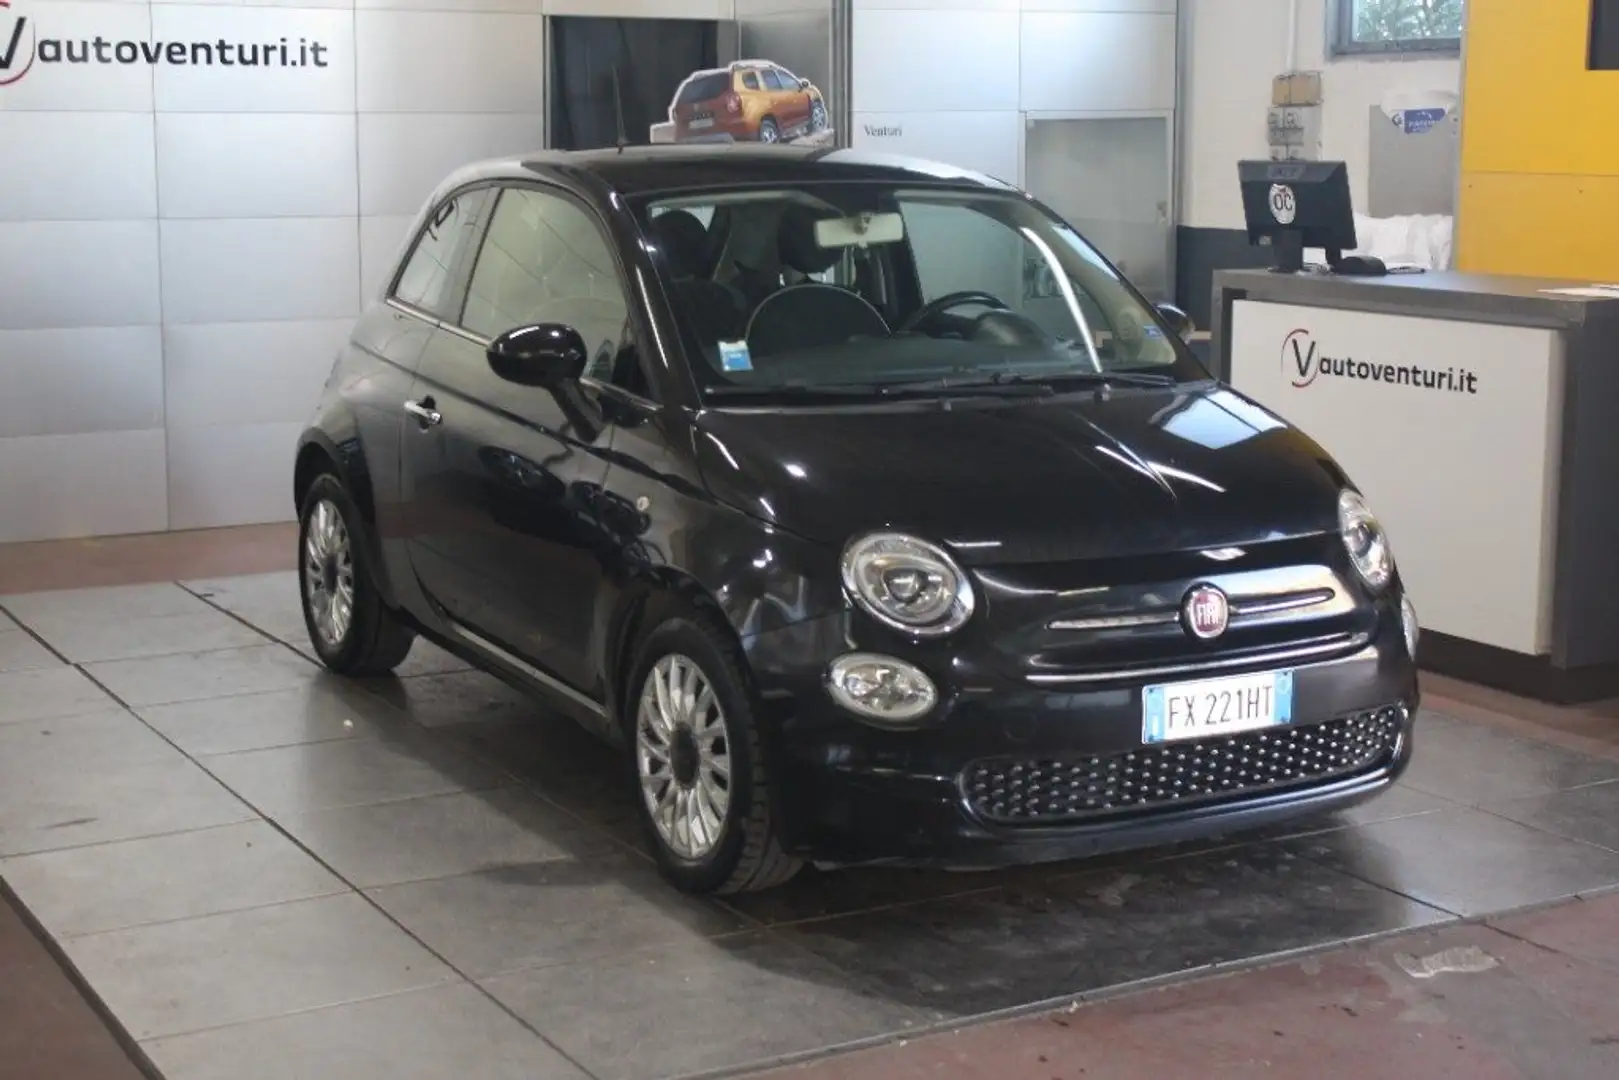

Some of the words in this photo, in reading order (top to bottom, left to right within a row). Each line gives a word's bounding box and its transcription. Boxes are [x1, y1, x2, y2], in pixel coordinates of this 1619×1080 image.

[38, 36, 328, 67] autoventuri.it
[1319, 356, 1477, 394] autoventuri.it
[1168, 695, 1196, 728] FX
[1204, 686, 1272, 725] 221HT
